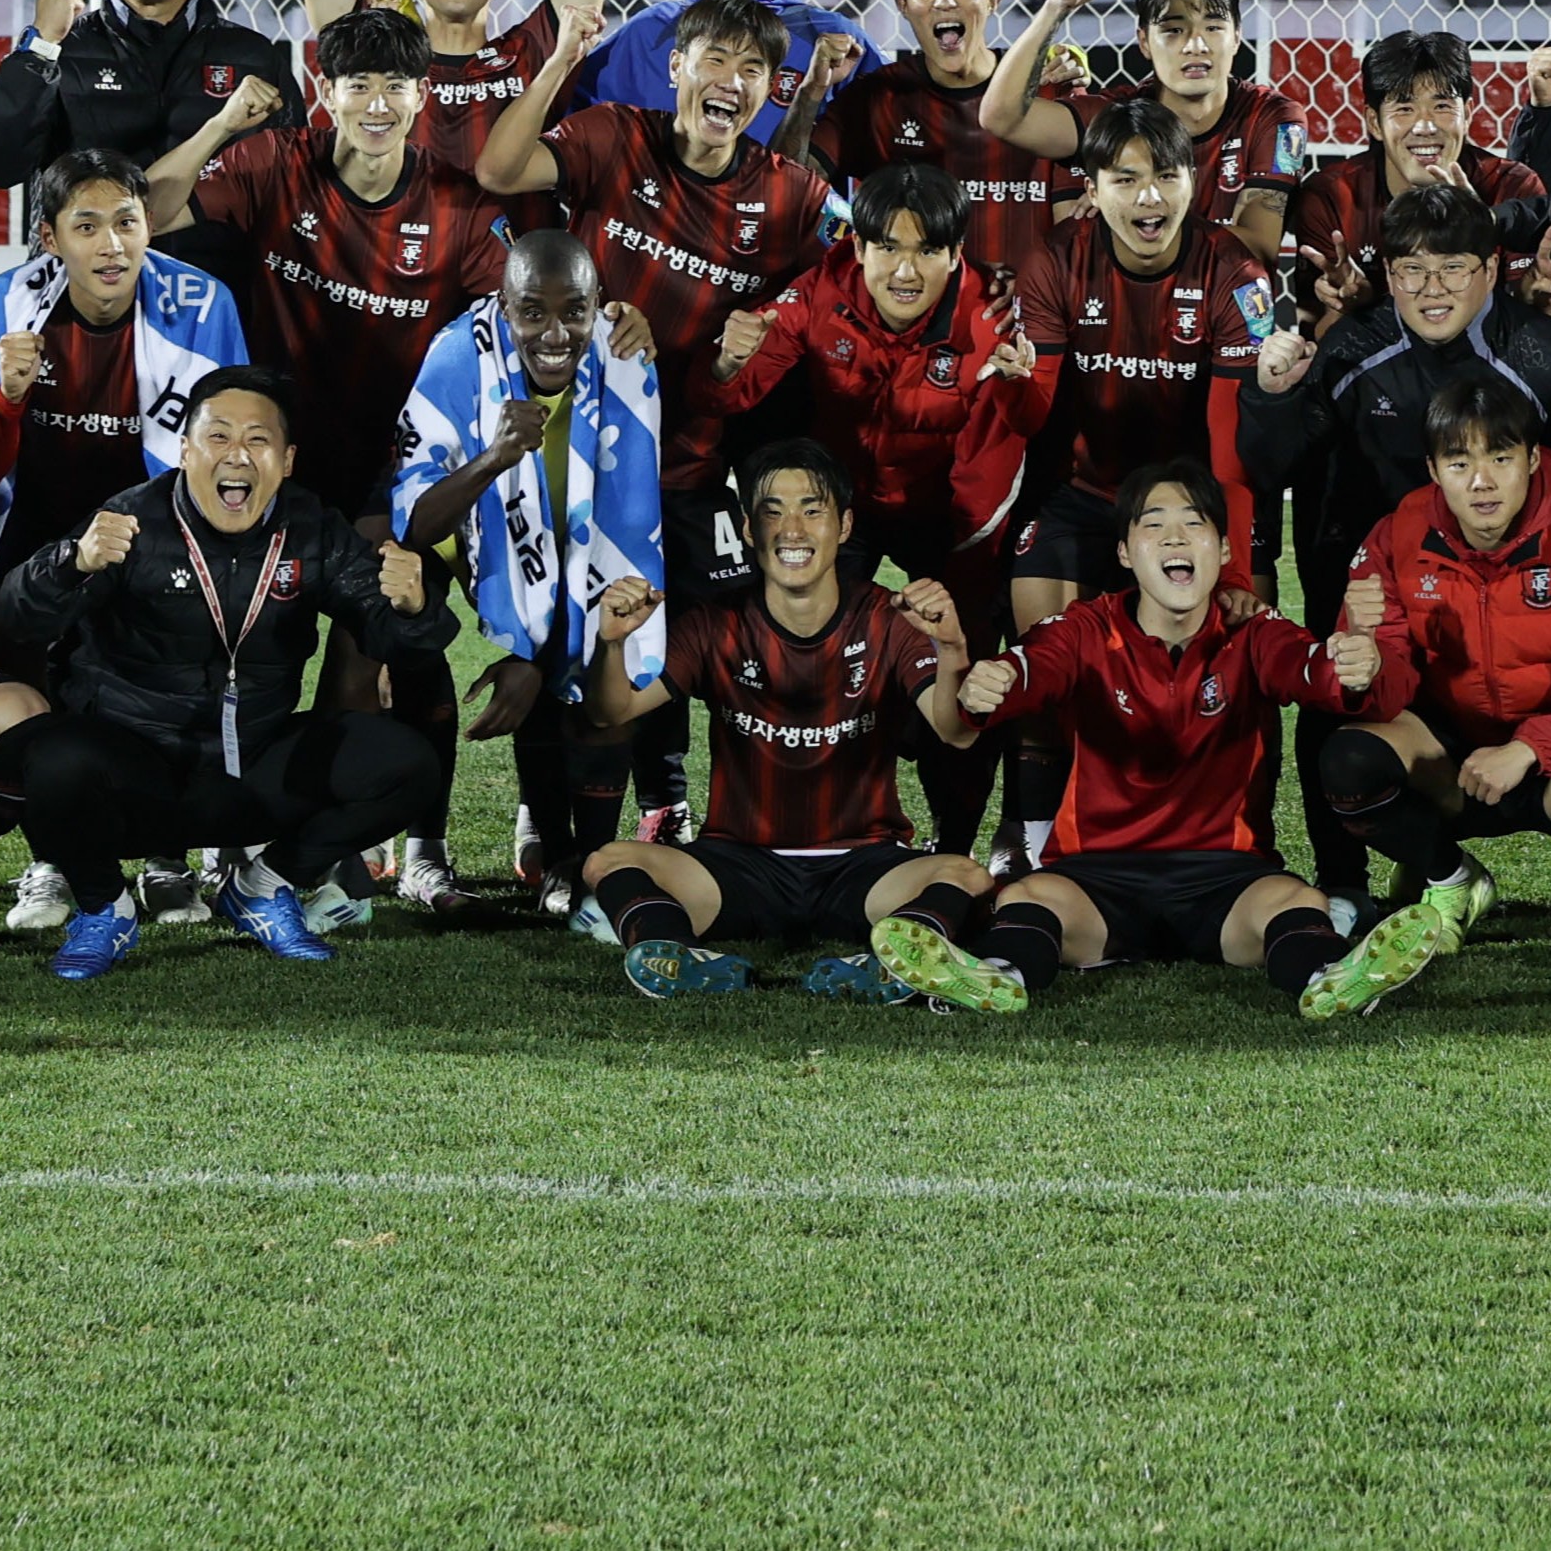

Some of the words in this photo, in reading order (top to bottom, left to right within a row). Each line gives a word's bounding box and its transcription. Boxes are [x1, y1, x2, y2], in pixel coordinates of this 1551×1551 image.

[433, 77, 524, 105] 생한방병원
[894, 137, 925, 147] KELME
[958, 178, 1046, 202] 한방병원
[264, 250, 431, 319] 부천자생한방병원
[712, 509, 744, 565] 4
